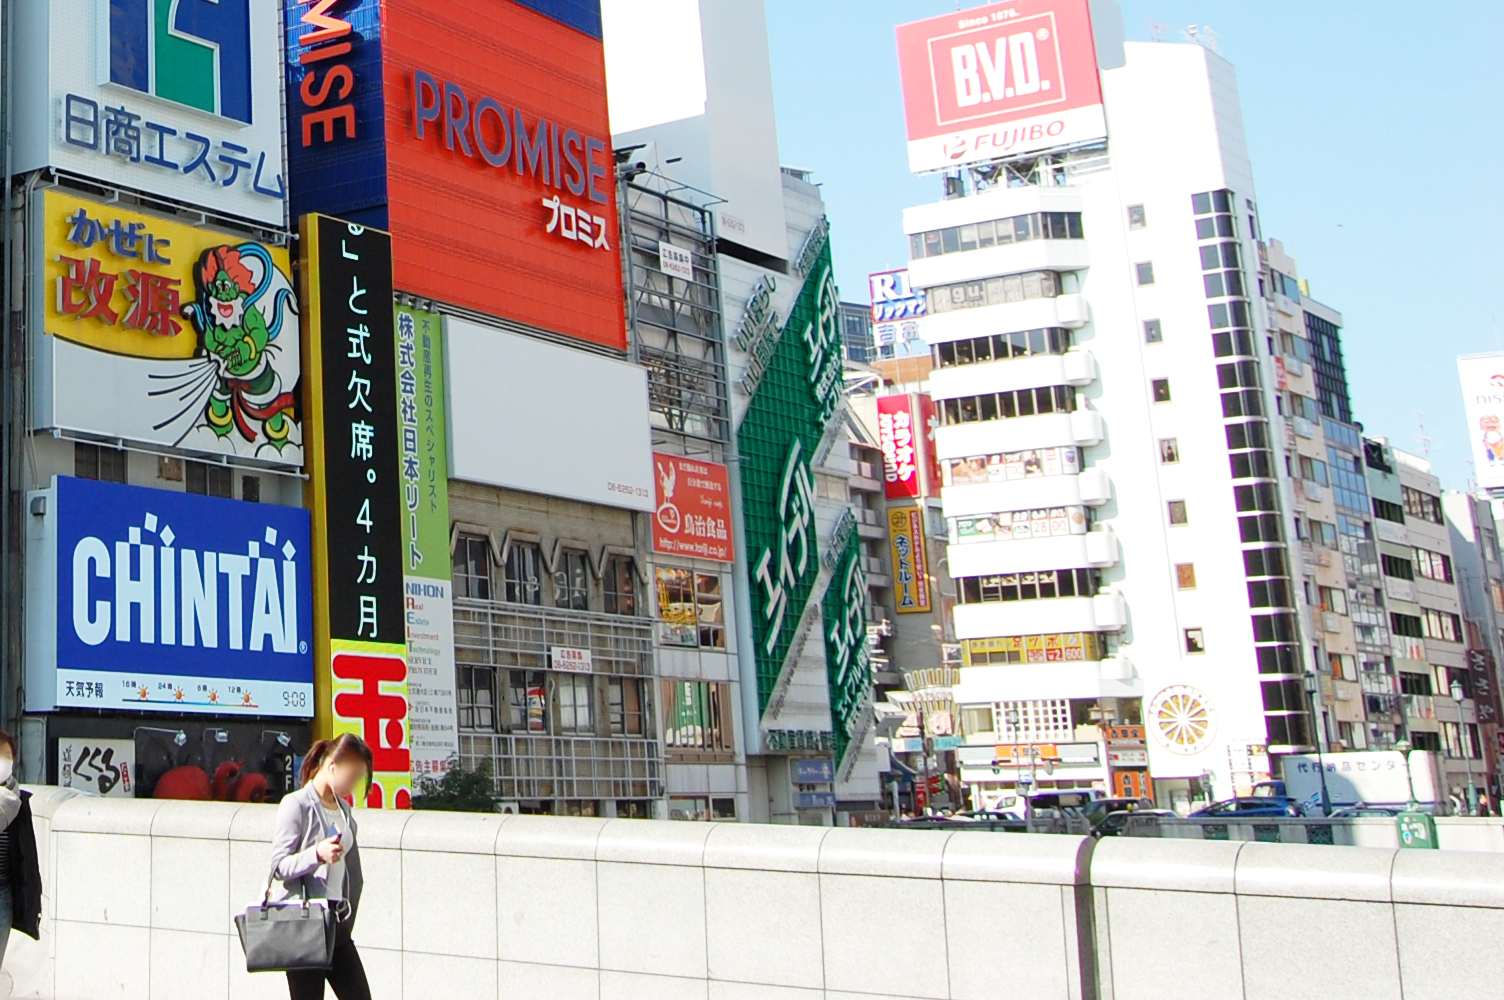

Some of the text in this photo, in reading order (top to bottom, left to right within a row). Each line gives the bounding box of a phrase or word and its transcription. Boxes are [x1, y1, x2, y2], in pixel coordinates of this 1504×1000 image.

[958, 13, 988, 30] Since
[950, 31, 1052, 109] B.V.D.
[65, 92, 285, 199] 日商エステム
[412, 68, 609, 205] PROMISE
[974, 119, 1066, 151] FUJIBO
[65, 206, 172, 266] かぜに
[542, 194, 611, 251] プロミス
[54, 252, 183, 337] 改源
[870, 270, 927, 303] RI
[397, 312, 424, 570] 株式会社日本リート
[421, 318, 439, 515] 不動産再生のスペシャリスト
[893, 412, 916, 483] カラオケ
[72, 511, 298, 654] CHINTAI
[405, 581, 445, 599] NIHON
[895, 534, 915, 607] ネットルーム
[64, 679, 105, 700] 天気予報
[282, 690, 307, 708] 9:08
[72, 745, 122, 795] くくる
